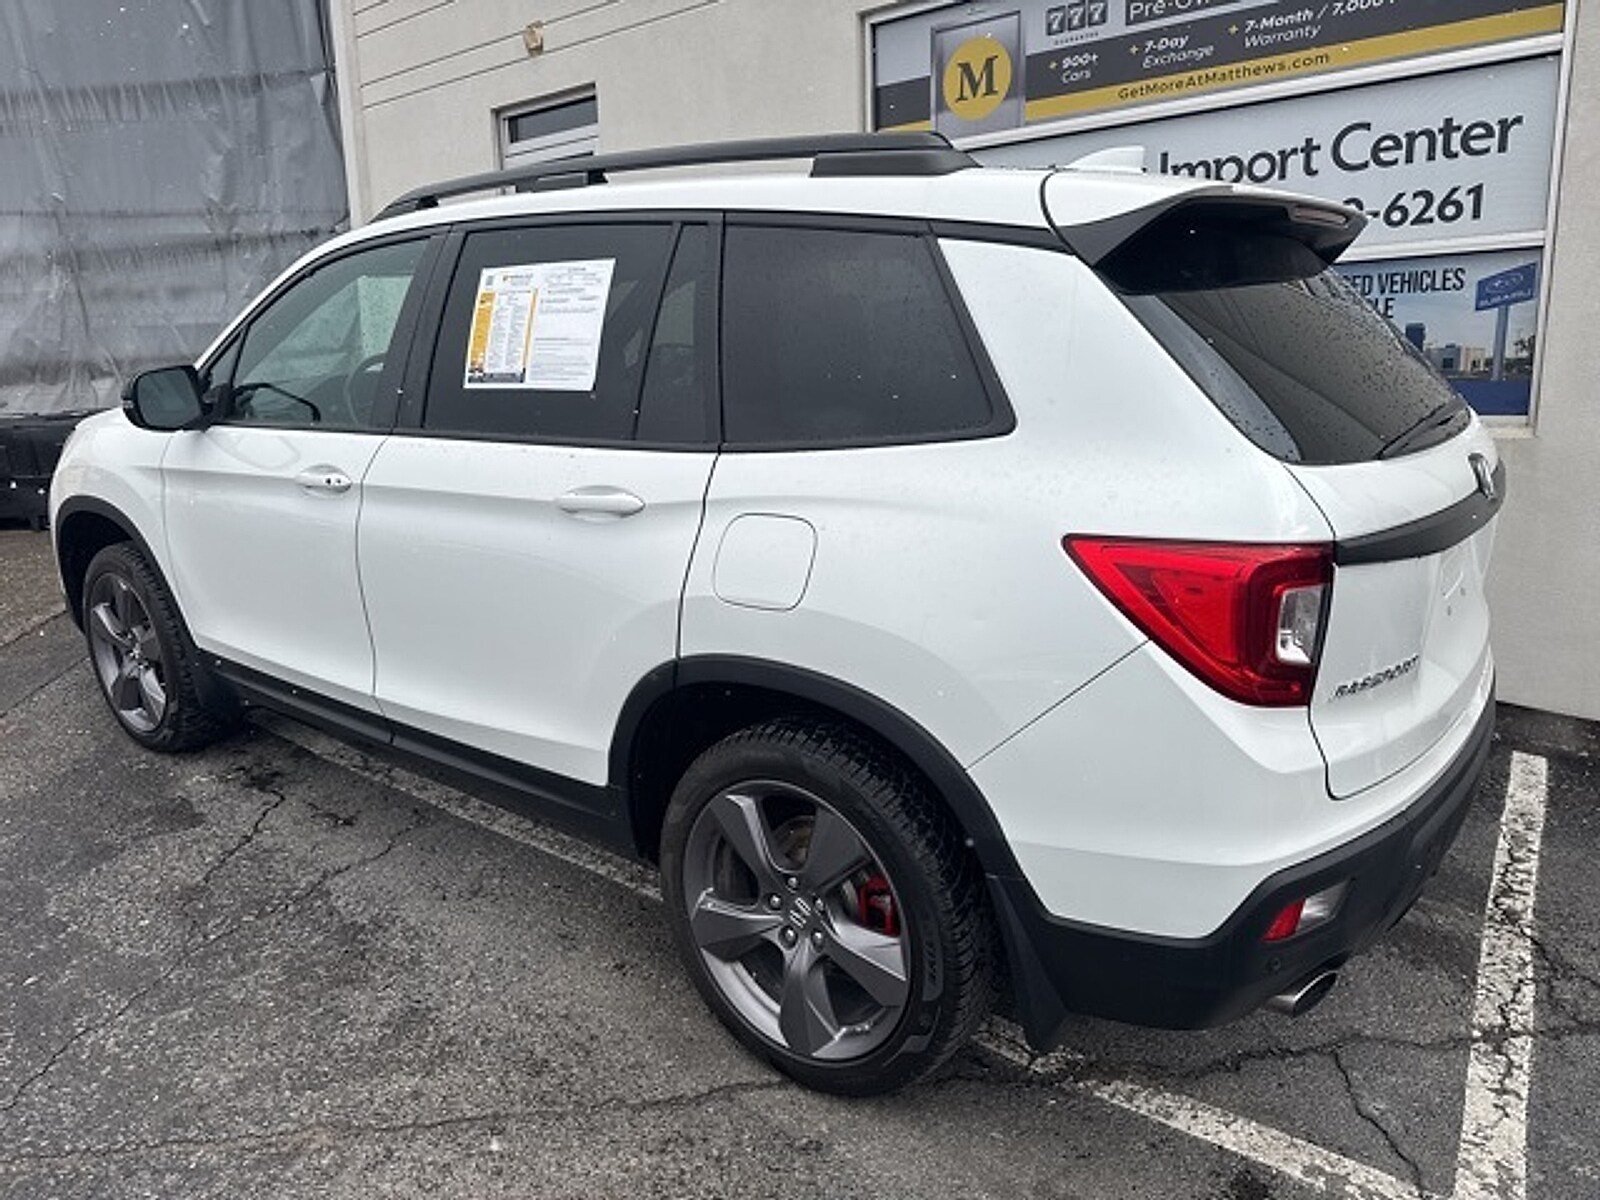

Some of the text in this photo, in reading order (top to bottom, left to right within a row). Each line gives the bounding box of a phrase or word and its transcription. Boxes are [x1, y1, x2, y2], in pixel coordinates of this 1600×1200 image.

[1244, 9, 1315, 34] 7-Month
[1144, 35, 1190, 54] 7-Day
[1244, 24, 1322, 49] Warranty
[1142, 45, 1214, 69] Exchange
[955, 54, 999, 103] M
[1062, 69, 1092, 84] Cars
[1117, 52, 1330, 100] GetMoreAtMatthews.com
[1331, 115, 1523, 172] Center
[1377, 267, 1466, 294] VEHICLES
